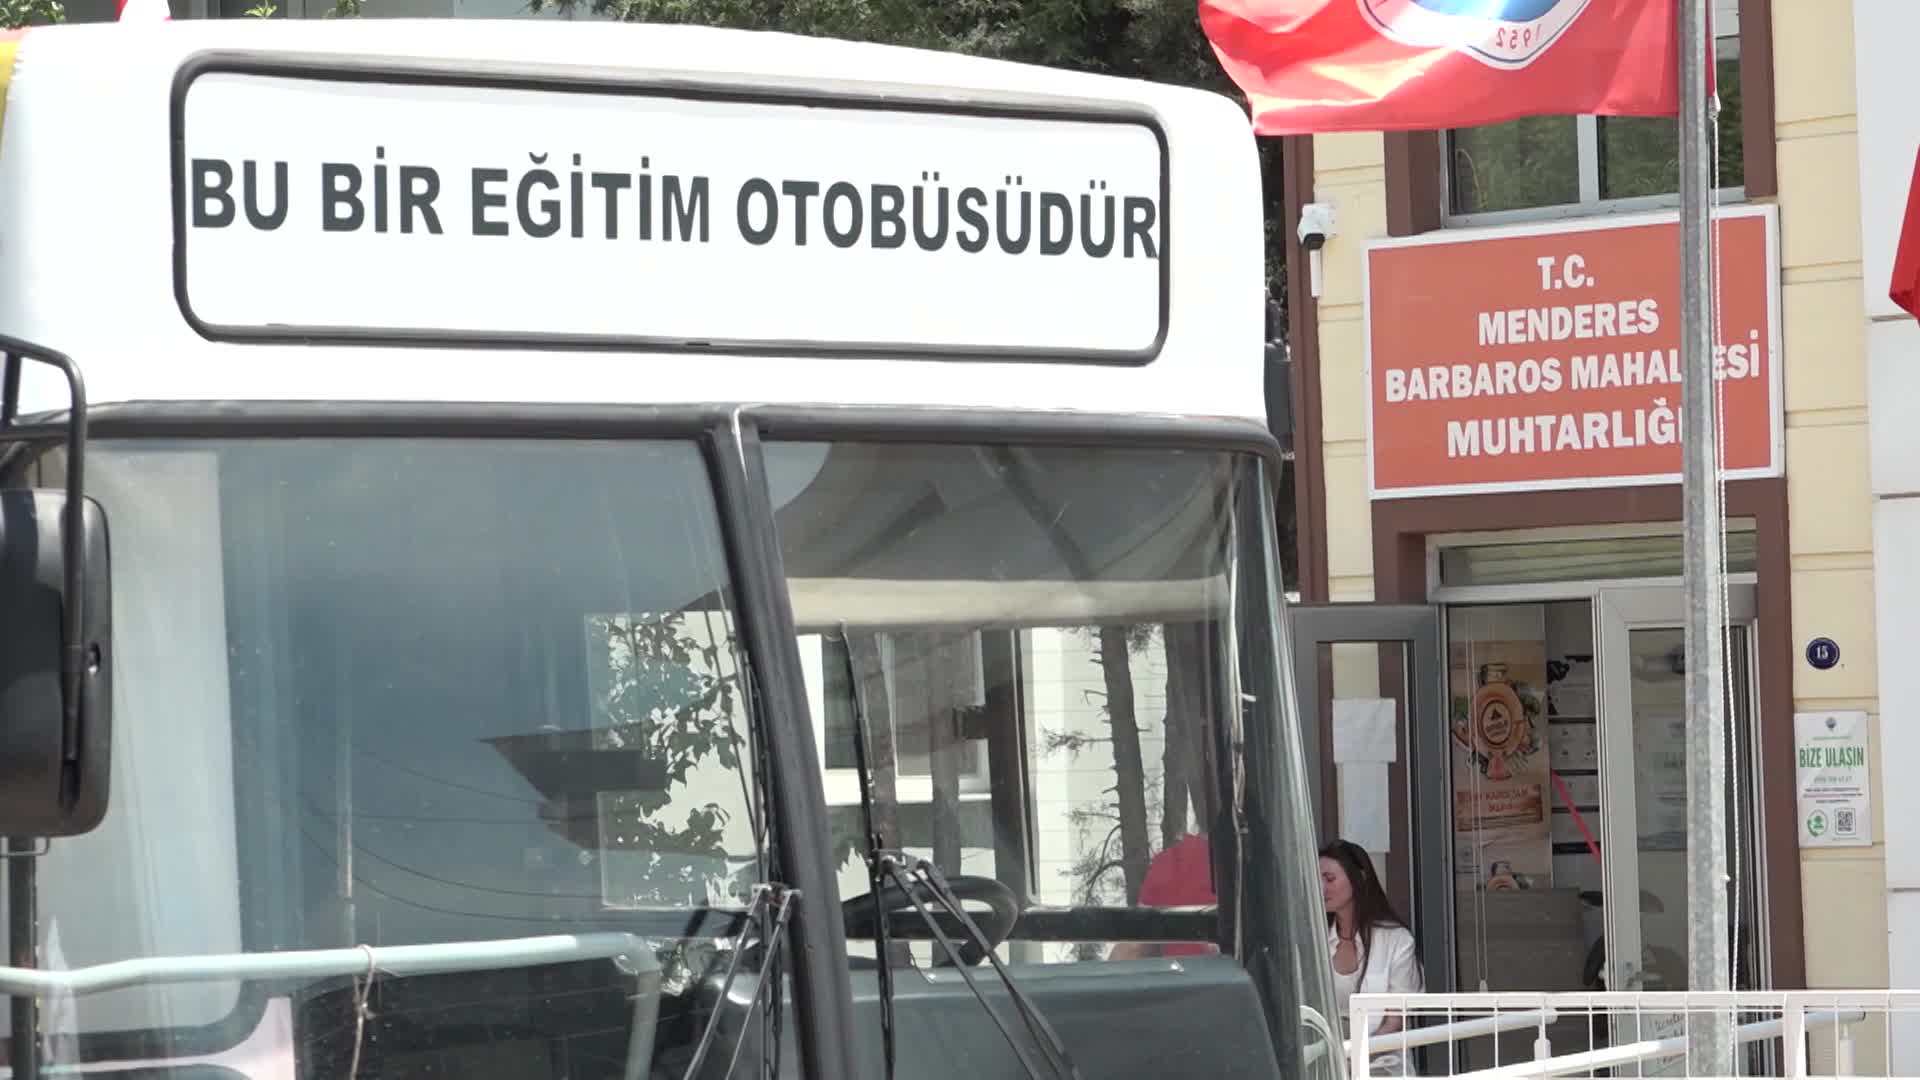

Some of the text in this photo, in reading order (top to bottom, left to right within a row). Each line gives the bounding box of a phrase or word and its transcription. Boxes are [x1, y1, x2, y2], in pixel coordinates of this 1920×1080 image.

[192, 145, 1160, 260] BU BİR EĞİTİM OTOBÜSÜDÜR
[1537, 254, 1595, 291] T.C.
[1478, 299, 1660, 346] MENDERES
[1385, 329, 1760, 402] BARBAROS MAHALESİ
[1816, 645, 1829, 660] 15
[1799, 744, 1864, 771] BİZE ULAŞIN
